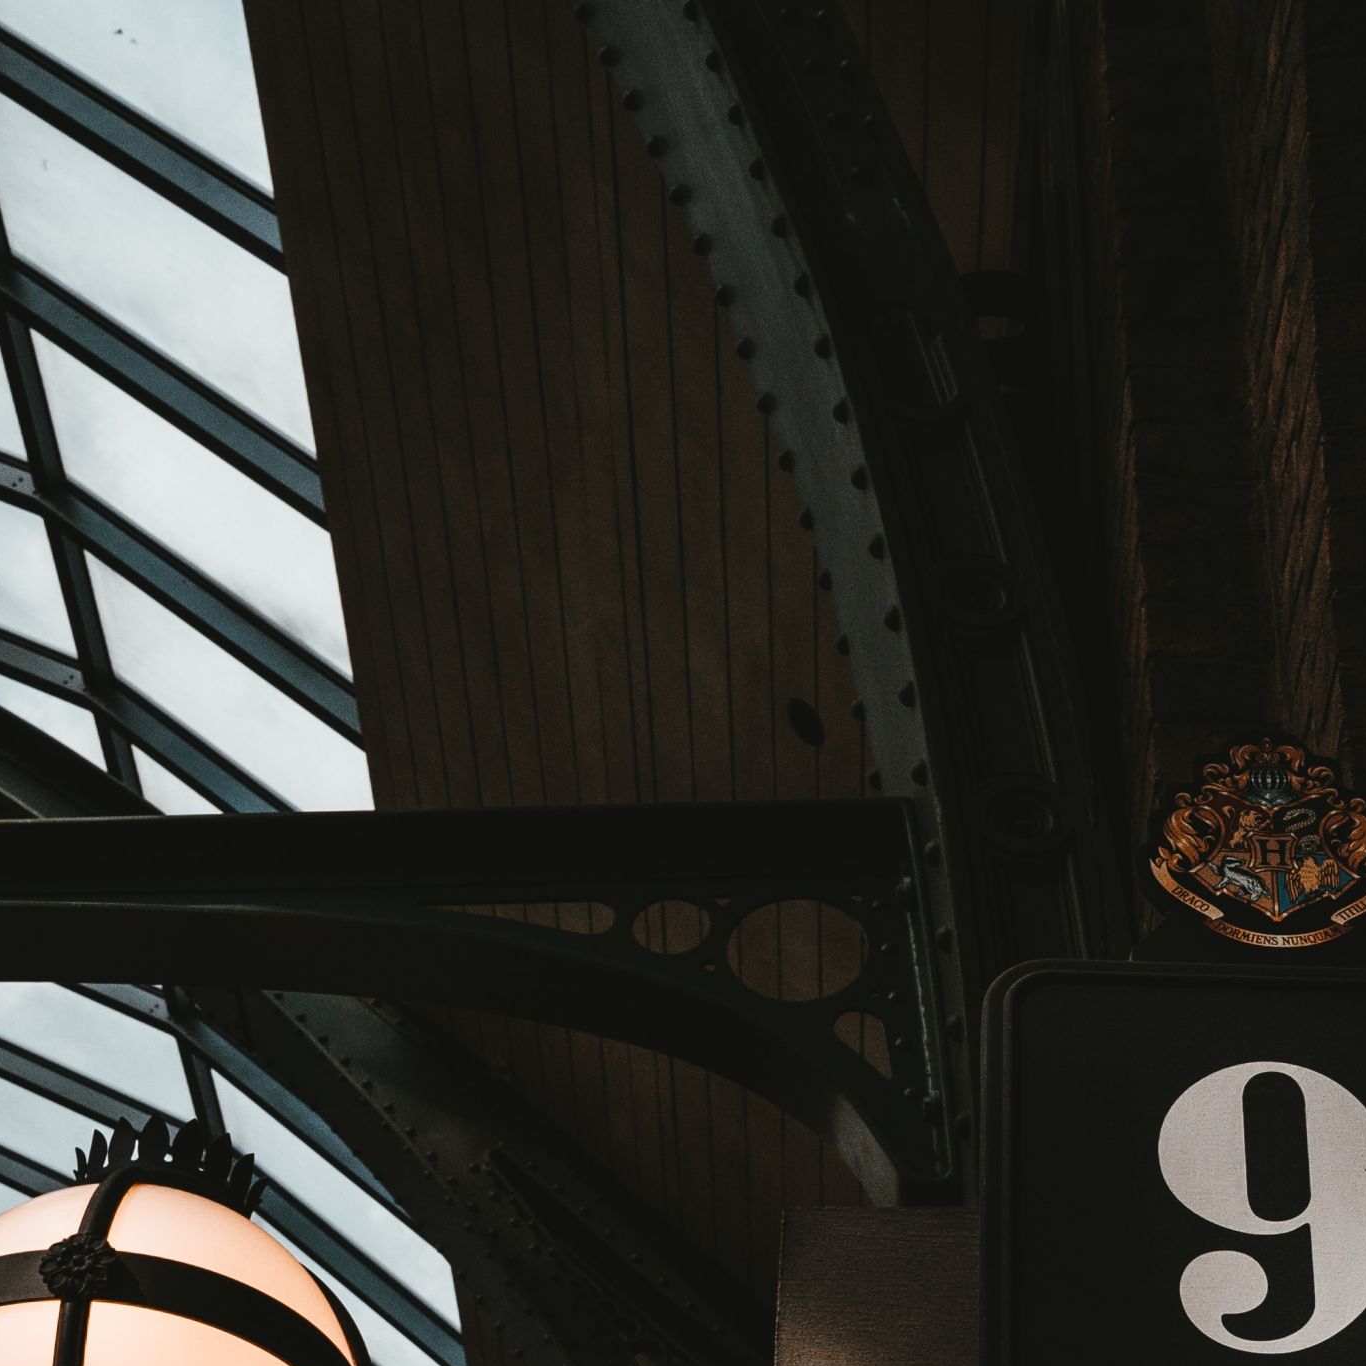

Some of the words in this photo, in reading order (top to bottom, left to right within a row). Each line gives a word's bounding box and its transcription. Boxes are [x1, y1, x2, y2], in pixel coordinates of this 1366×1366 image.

[1260, 838, 1289, 865] H
[1171, 885, 1209, 912] DRACO
[1215, 921, 1279, 945] DORMIENS
